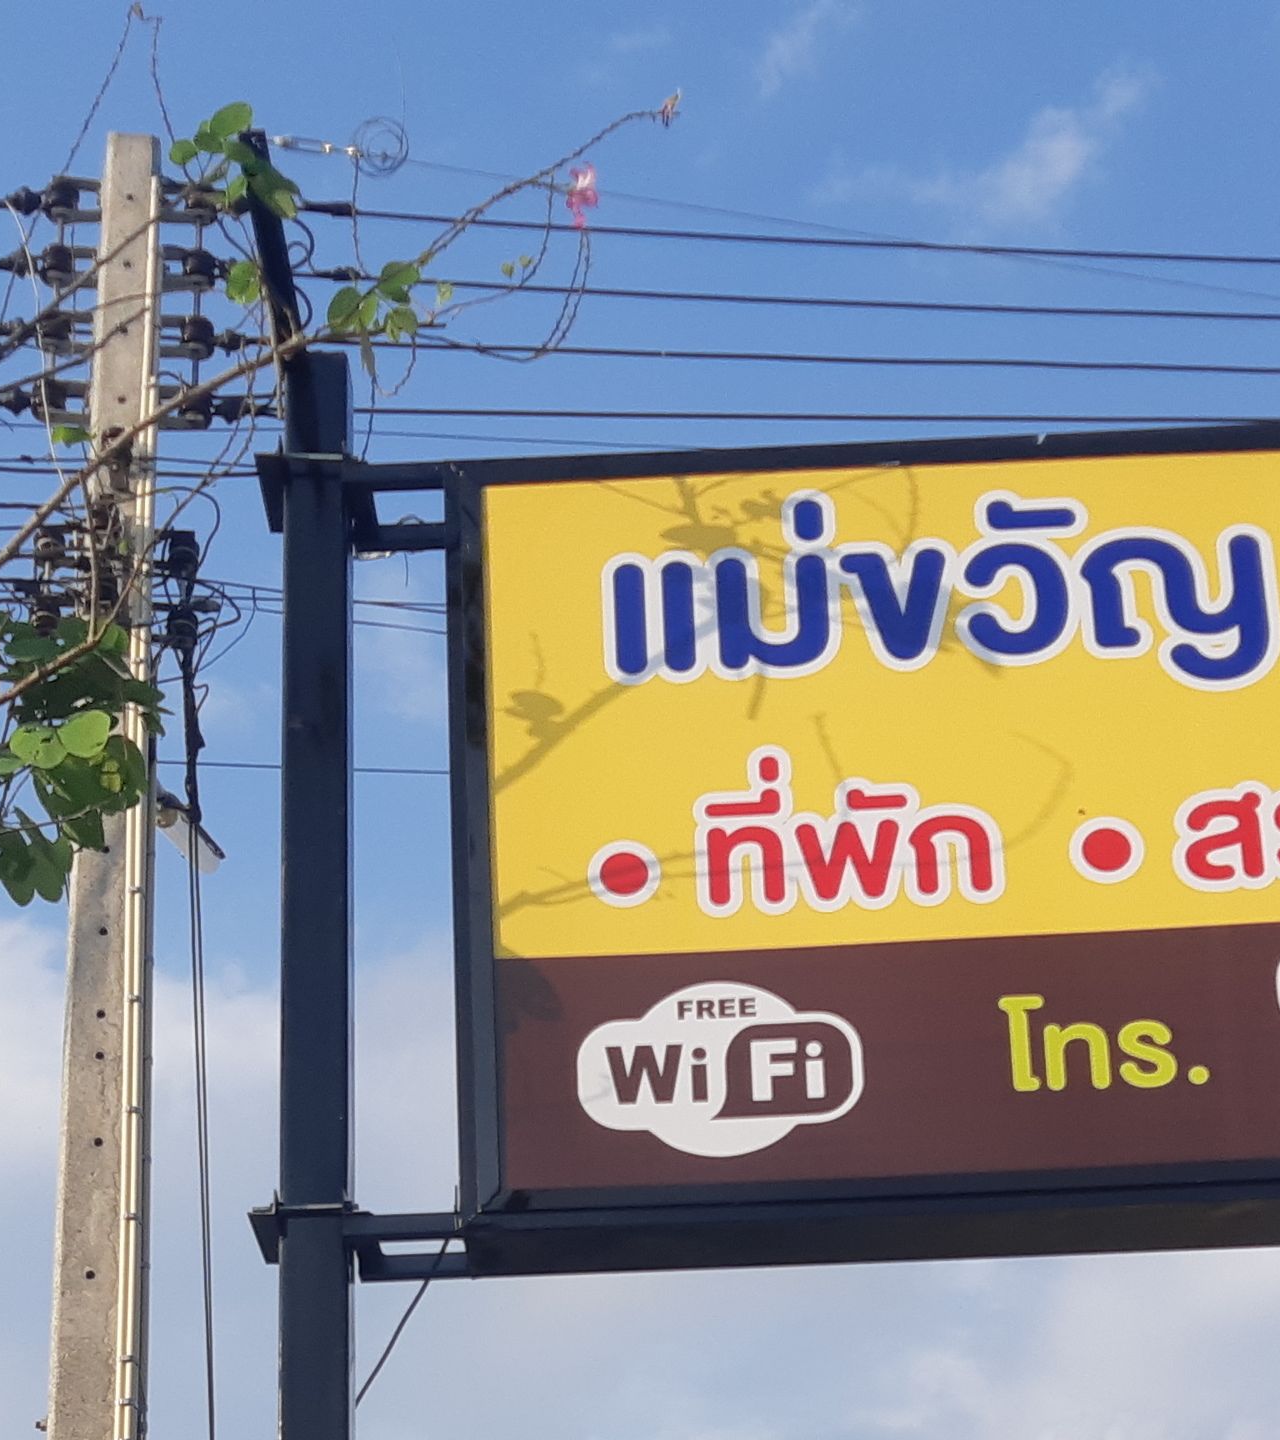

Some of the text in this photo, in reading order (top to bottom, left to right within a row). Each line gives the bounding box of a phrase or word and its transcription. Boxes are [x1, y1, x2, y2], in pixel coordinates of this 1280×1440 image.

[614, 499, 1269, 681] แม่ขวัญ
[705, 755, 995, 906] ที่พัก
[676, 997, 758, 1021] FREE
[997, 994, 1211, 1093] โทร.
